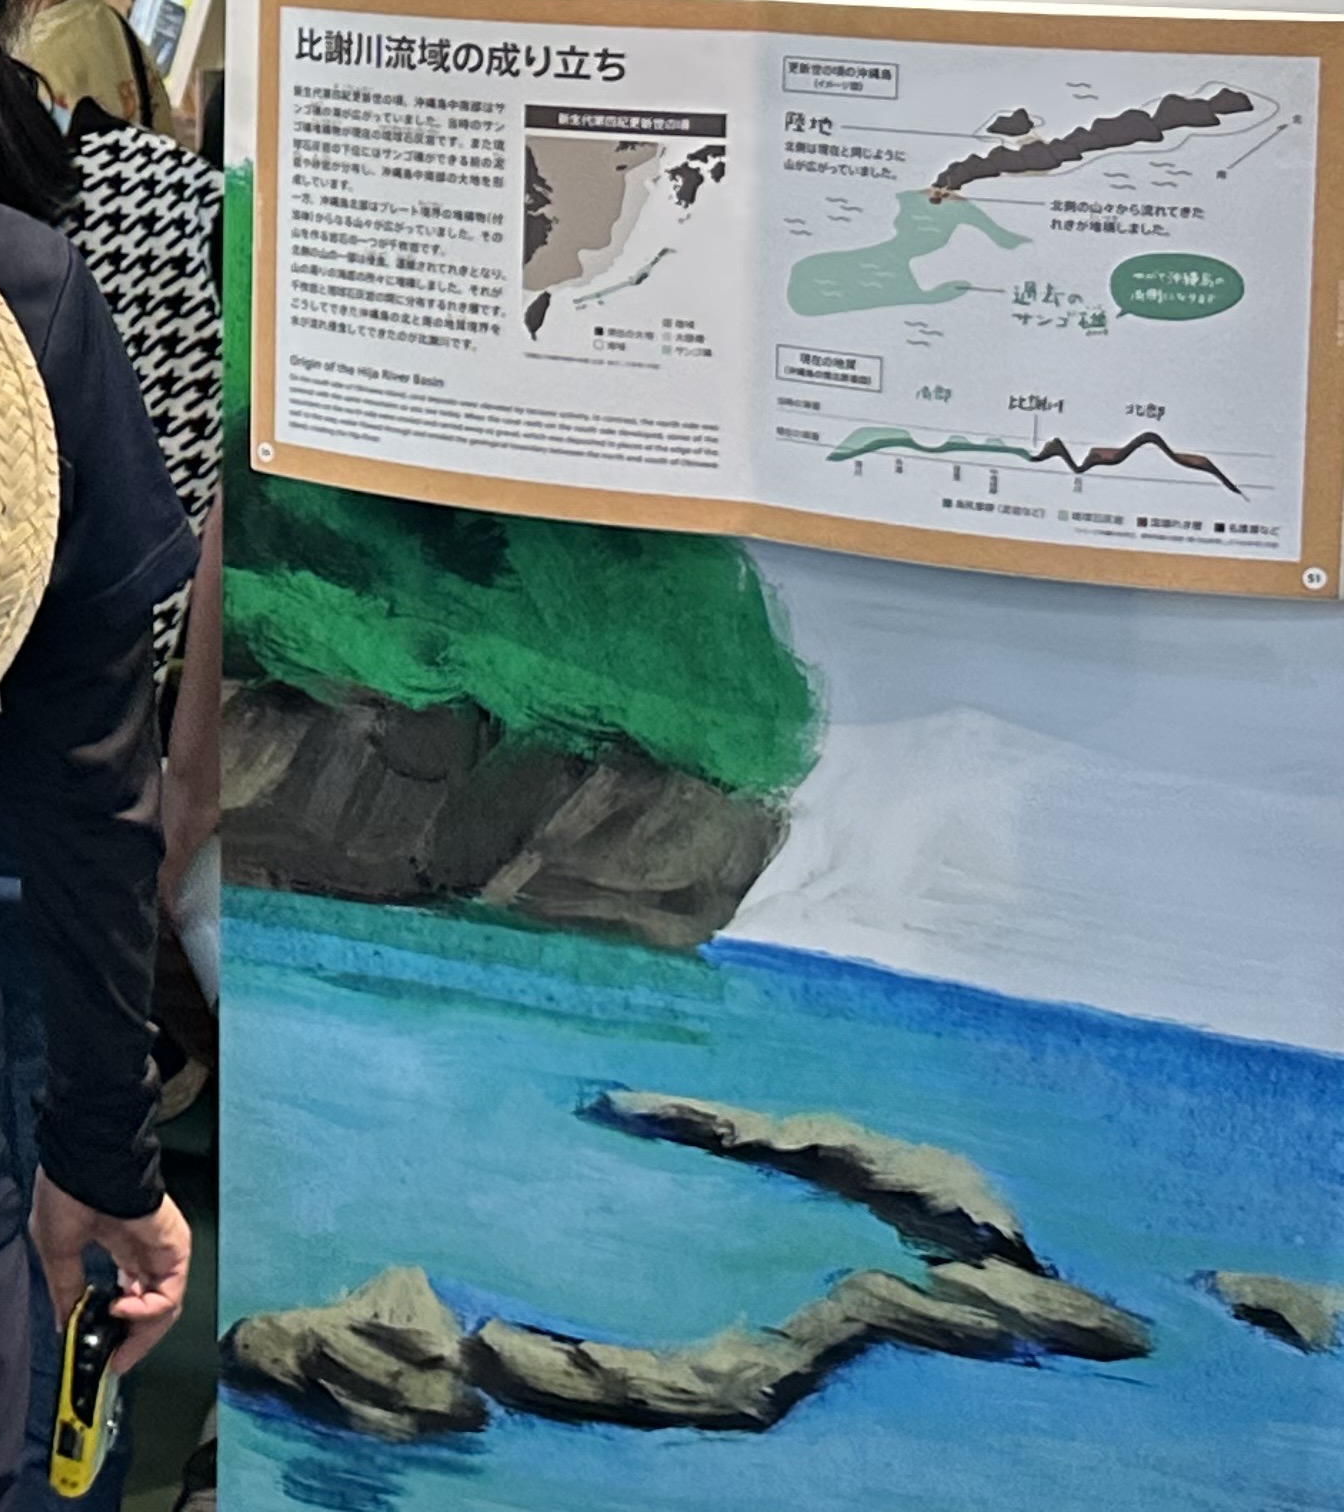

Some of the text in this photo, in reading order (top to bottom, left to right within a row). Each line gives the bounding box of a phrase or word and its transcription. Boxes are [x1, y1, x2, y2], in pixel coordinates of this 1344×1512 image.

[295, 28, 626, 82] 比謝川流域の成り立ち
[784, 111, 833, 136] 陸地
